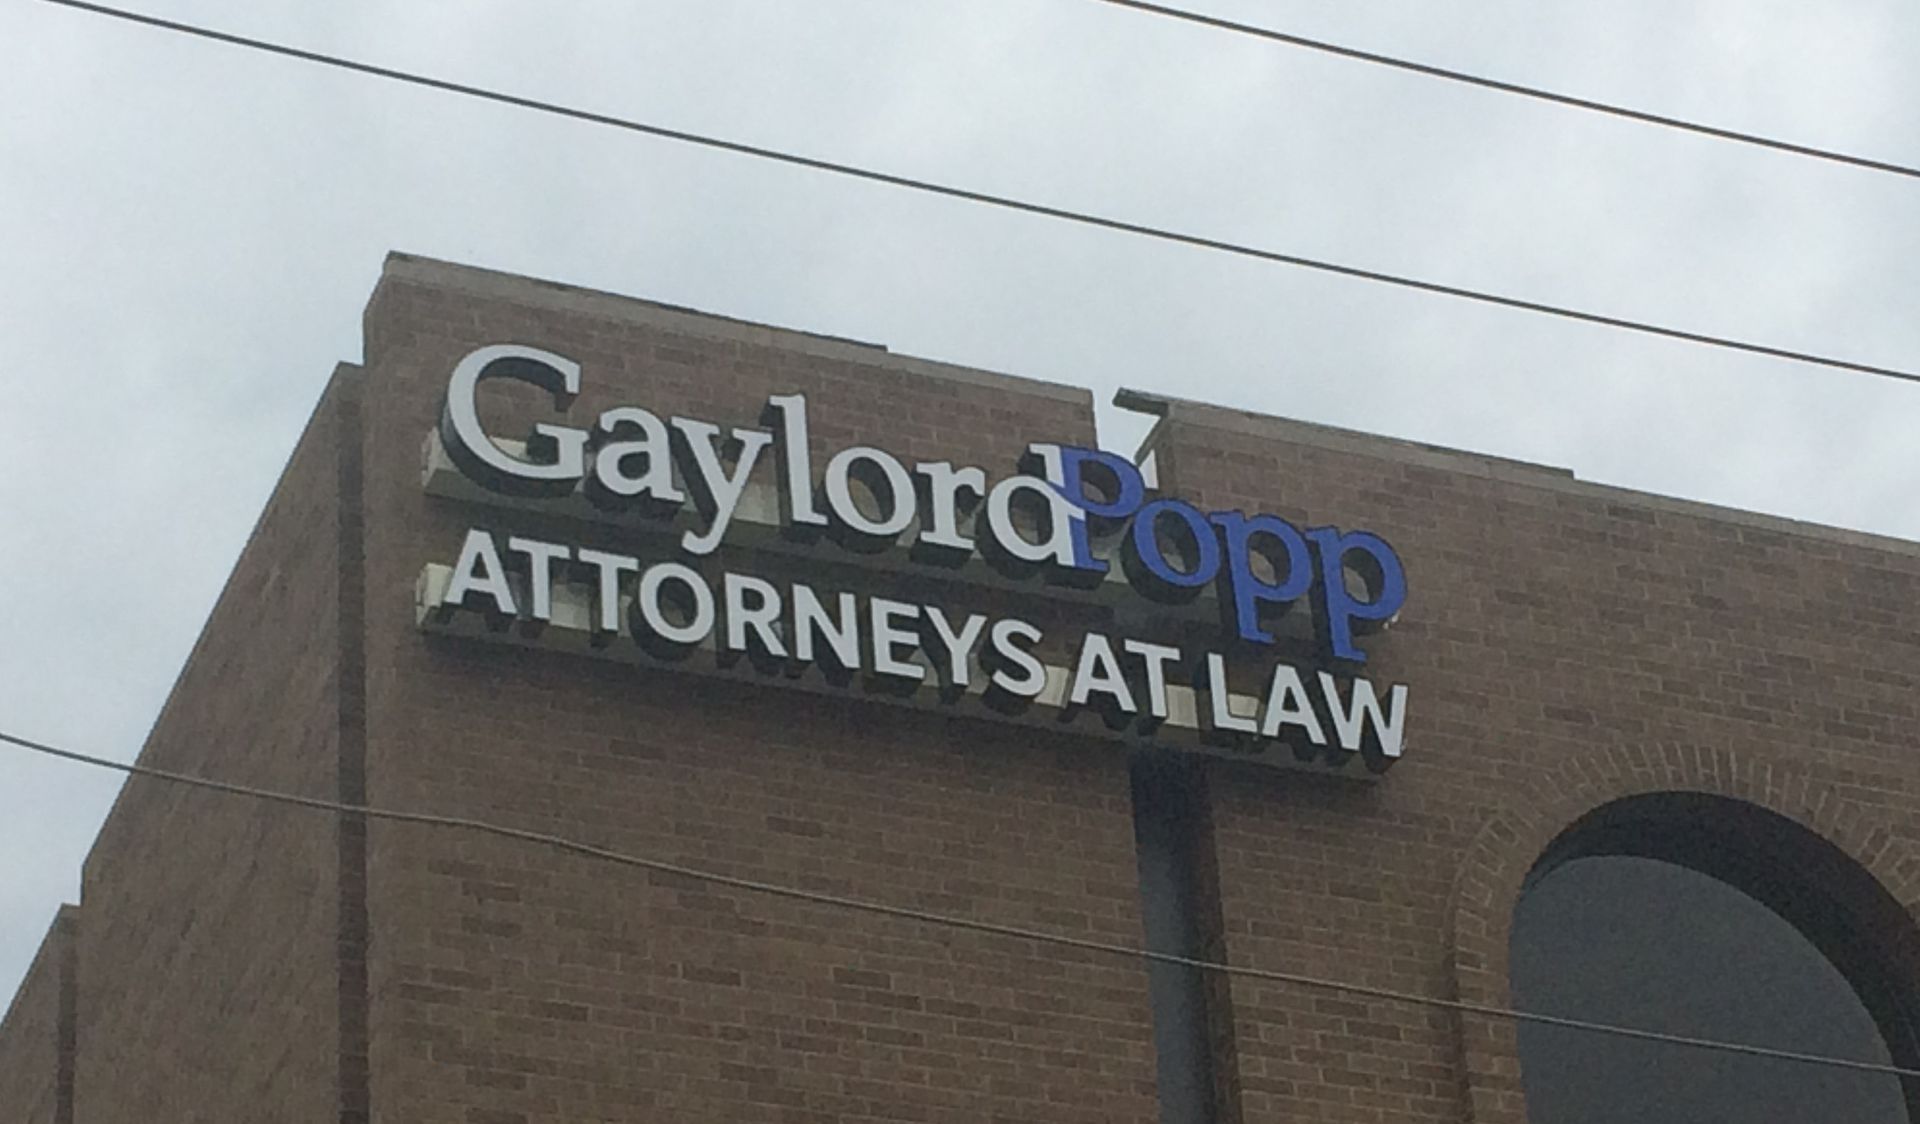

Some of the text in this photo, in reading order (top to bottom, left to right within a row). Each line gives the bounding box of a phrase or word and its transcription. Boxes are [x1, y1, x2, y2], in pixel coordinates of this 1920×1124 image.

[444, 528, 1408, 758] ATTORNEYS AT LAW
